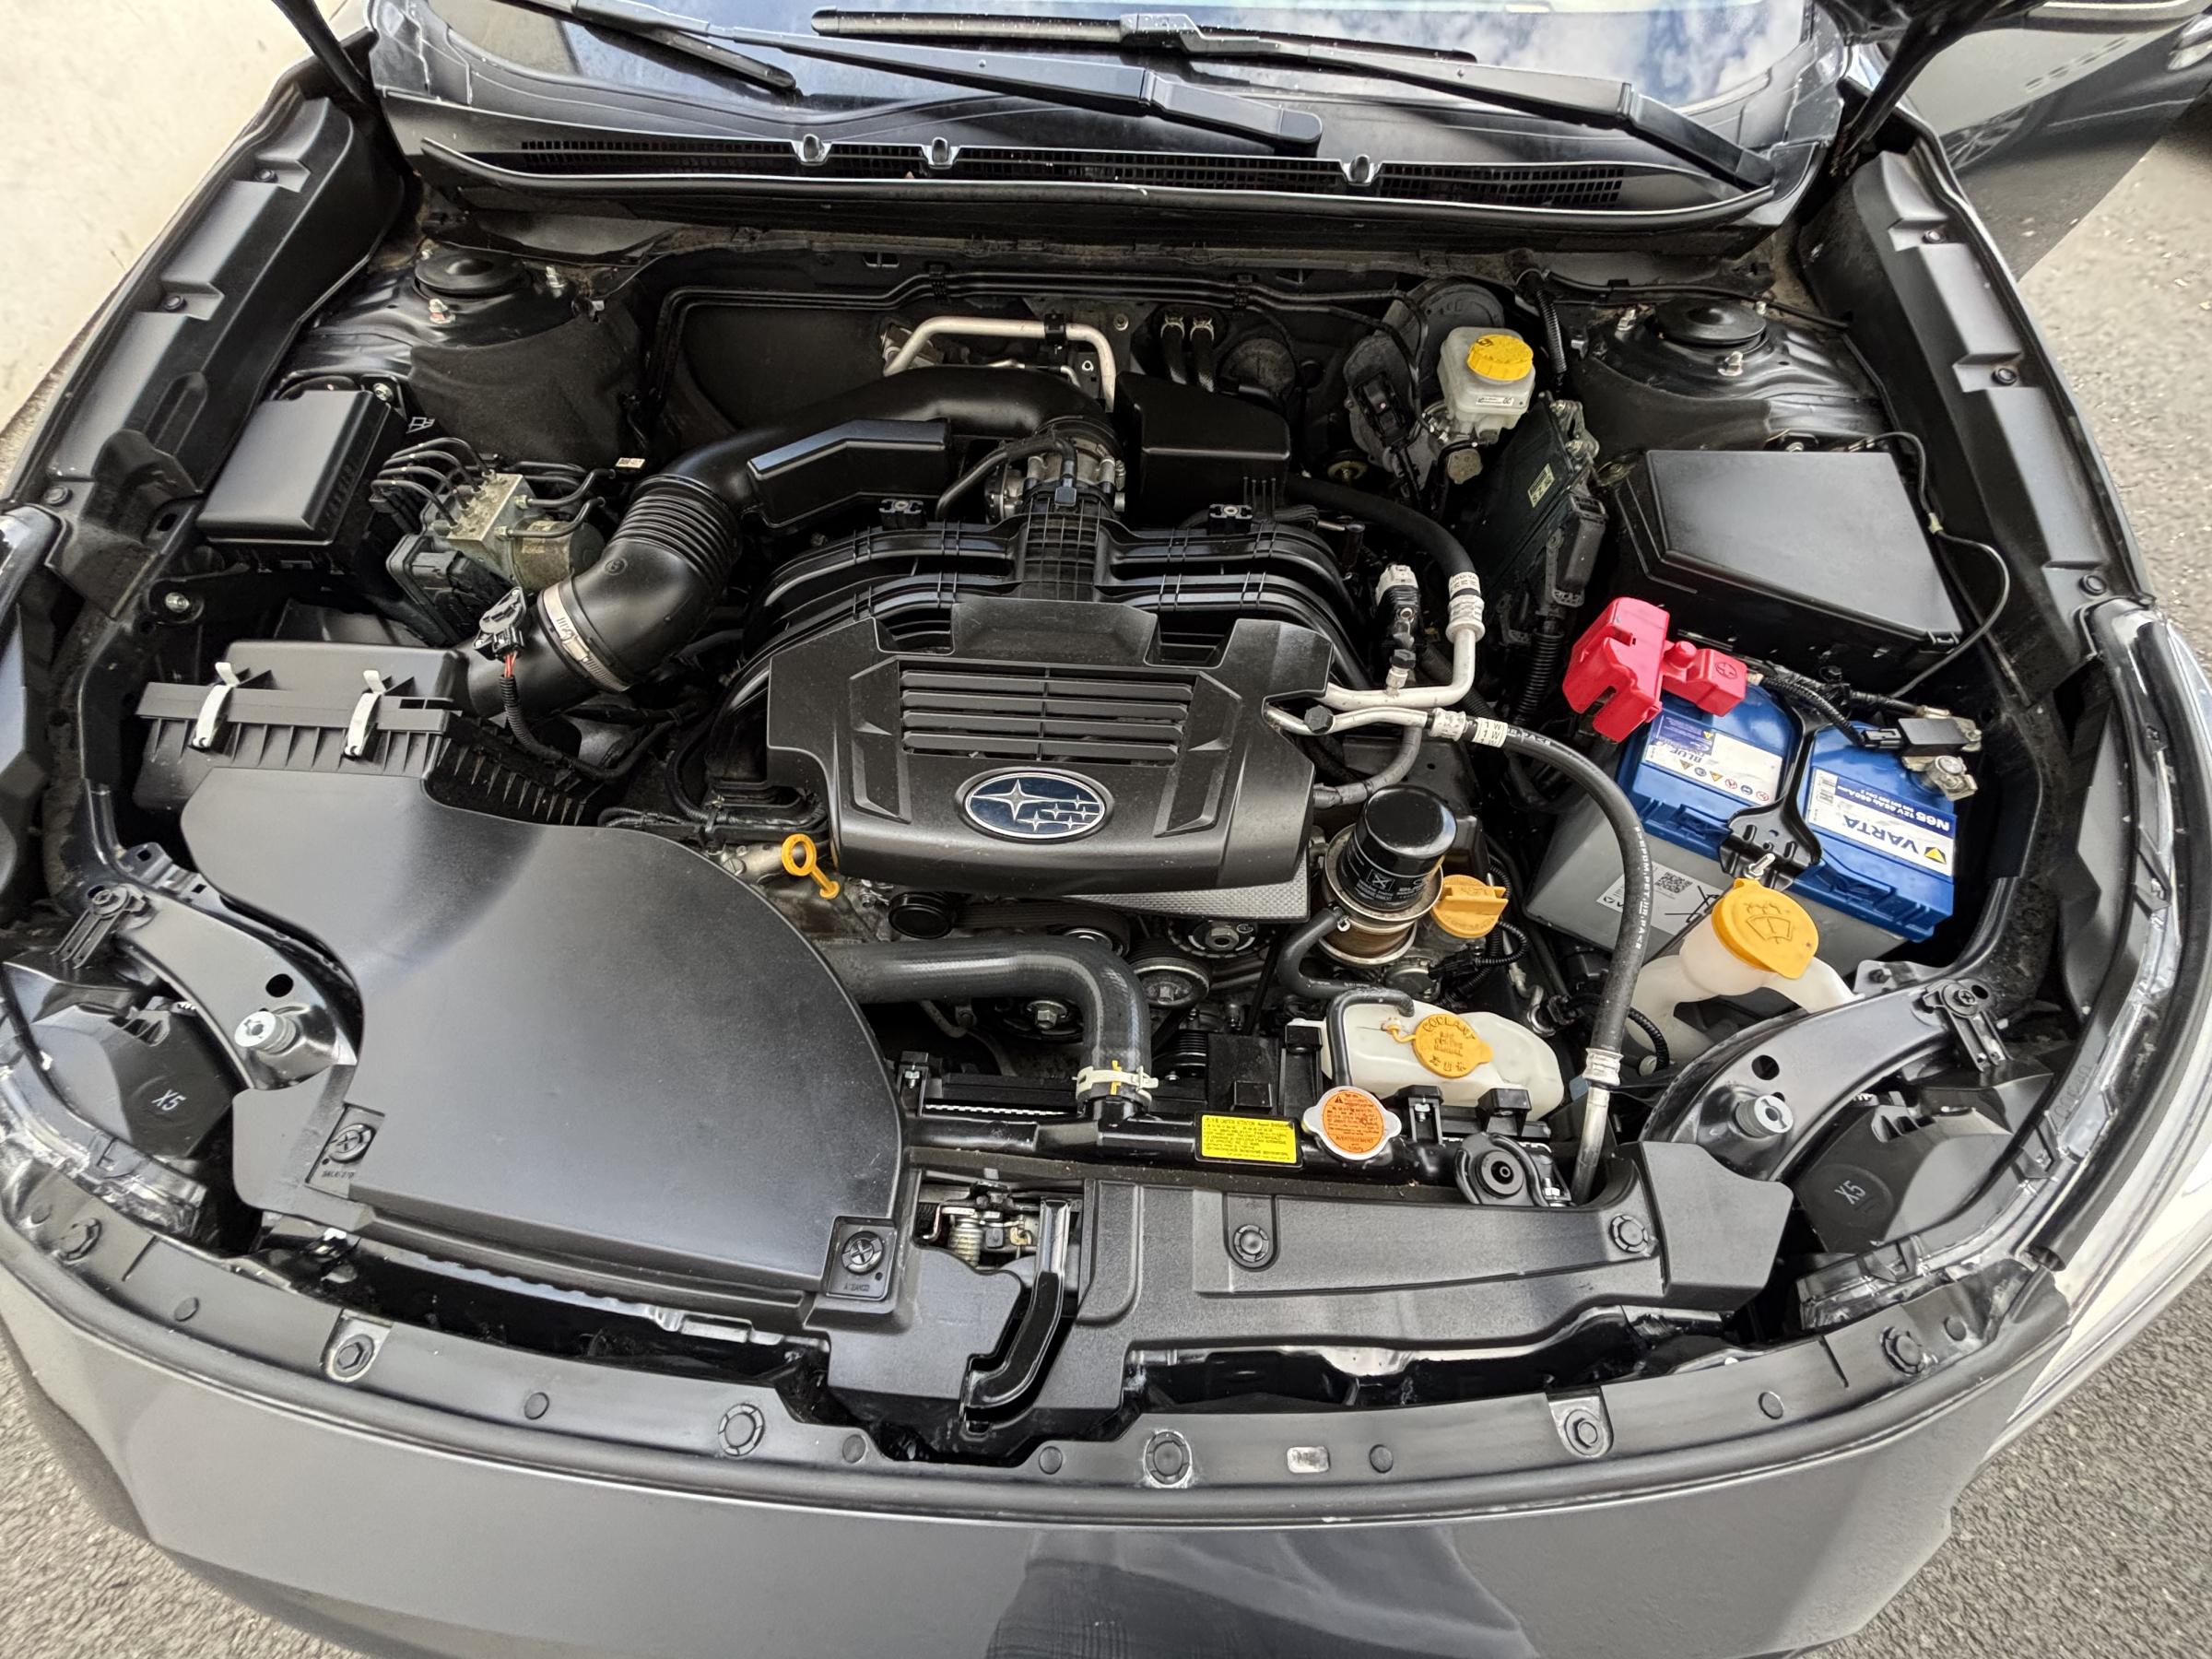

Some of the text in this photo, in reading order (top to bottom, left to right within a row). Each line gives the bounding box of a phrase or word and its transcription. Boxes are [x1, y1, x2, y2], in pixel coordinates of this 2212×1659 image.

[1842, 814, 1919, 854] VARTA
[151, 1088, 187, 1112] X5
[1834, 1180, 1866, 1206] X5
